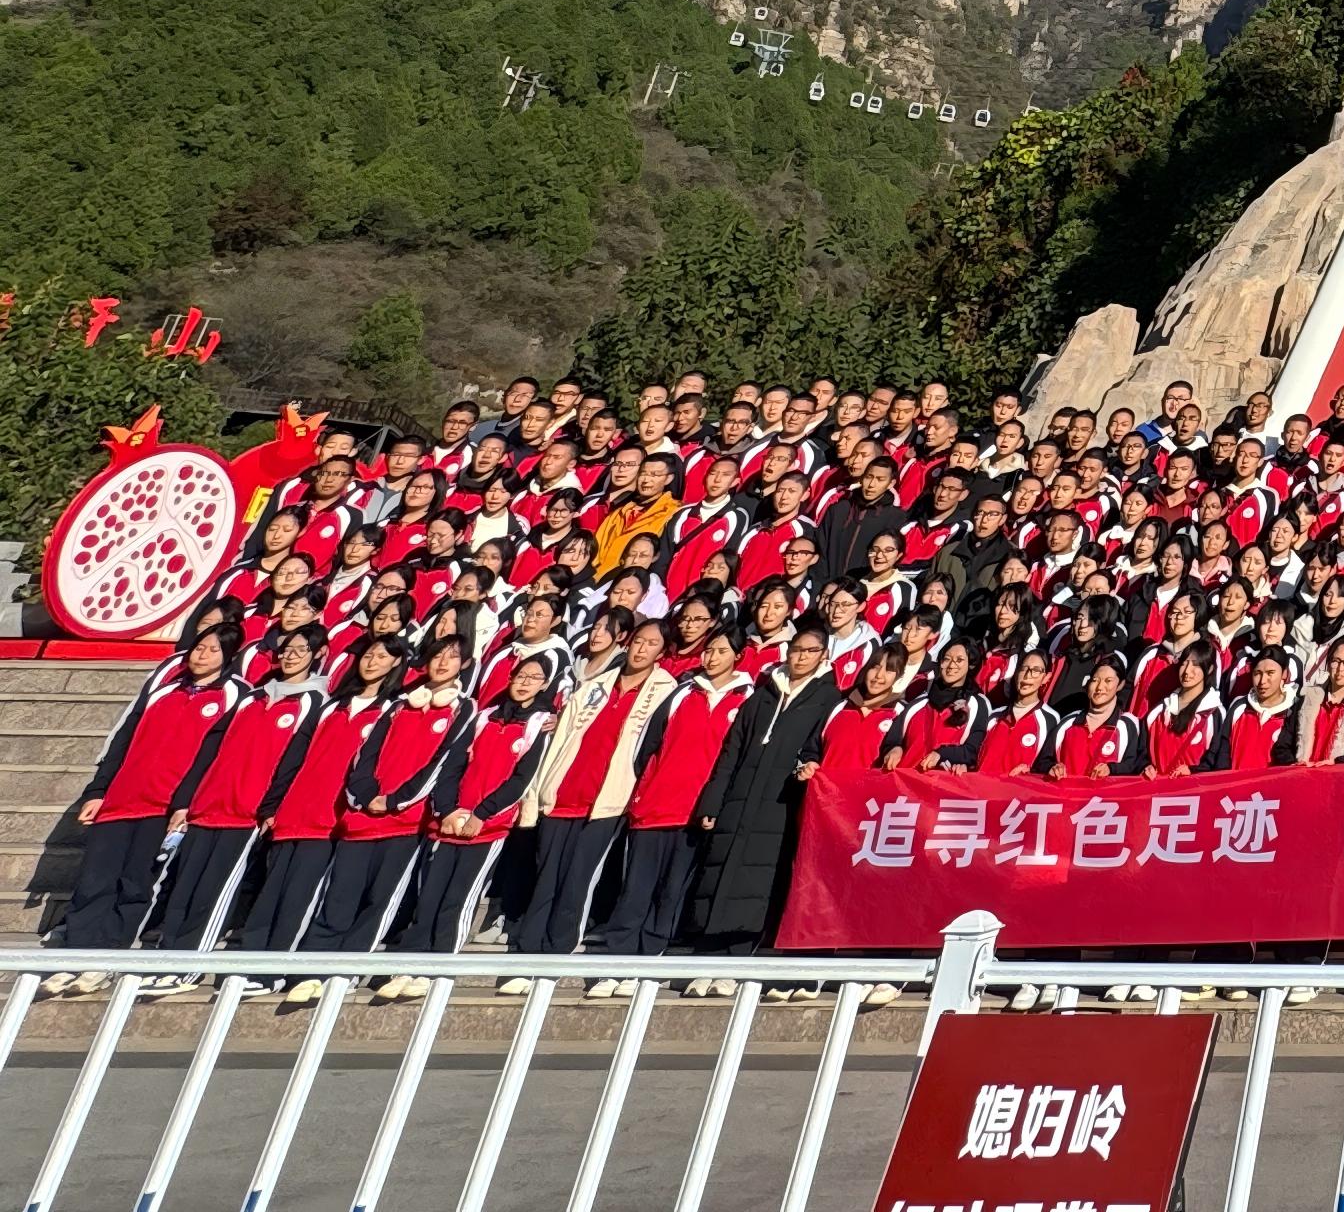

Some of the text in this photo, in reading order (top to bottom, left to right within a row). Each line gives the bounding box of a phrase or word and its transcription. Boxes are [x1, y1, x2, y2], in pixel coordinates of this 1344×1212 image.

[852, 792, 1280, 868] 追寻红色足迹
[957, 1084, 1127, 1161] 媳妇岭
